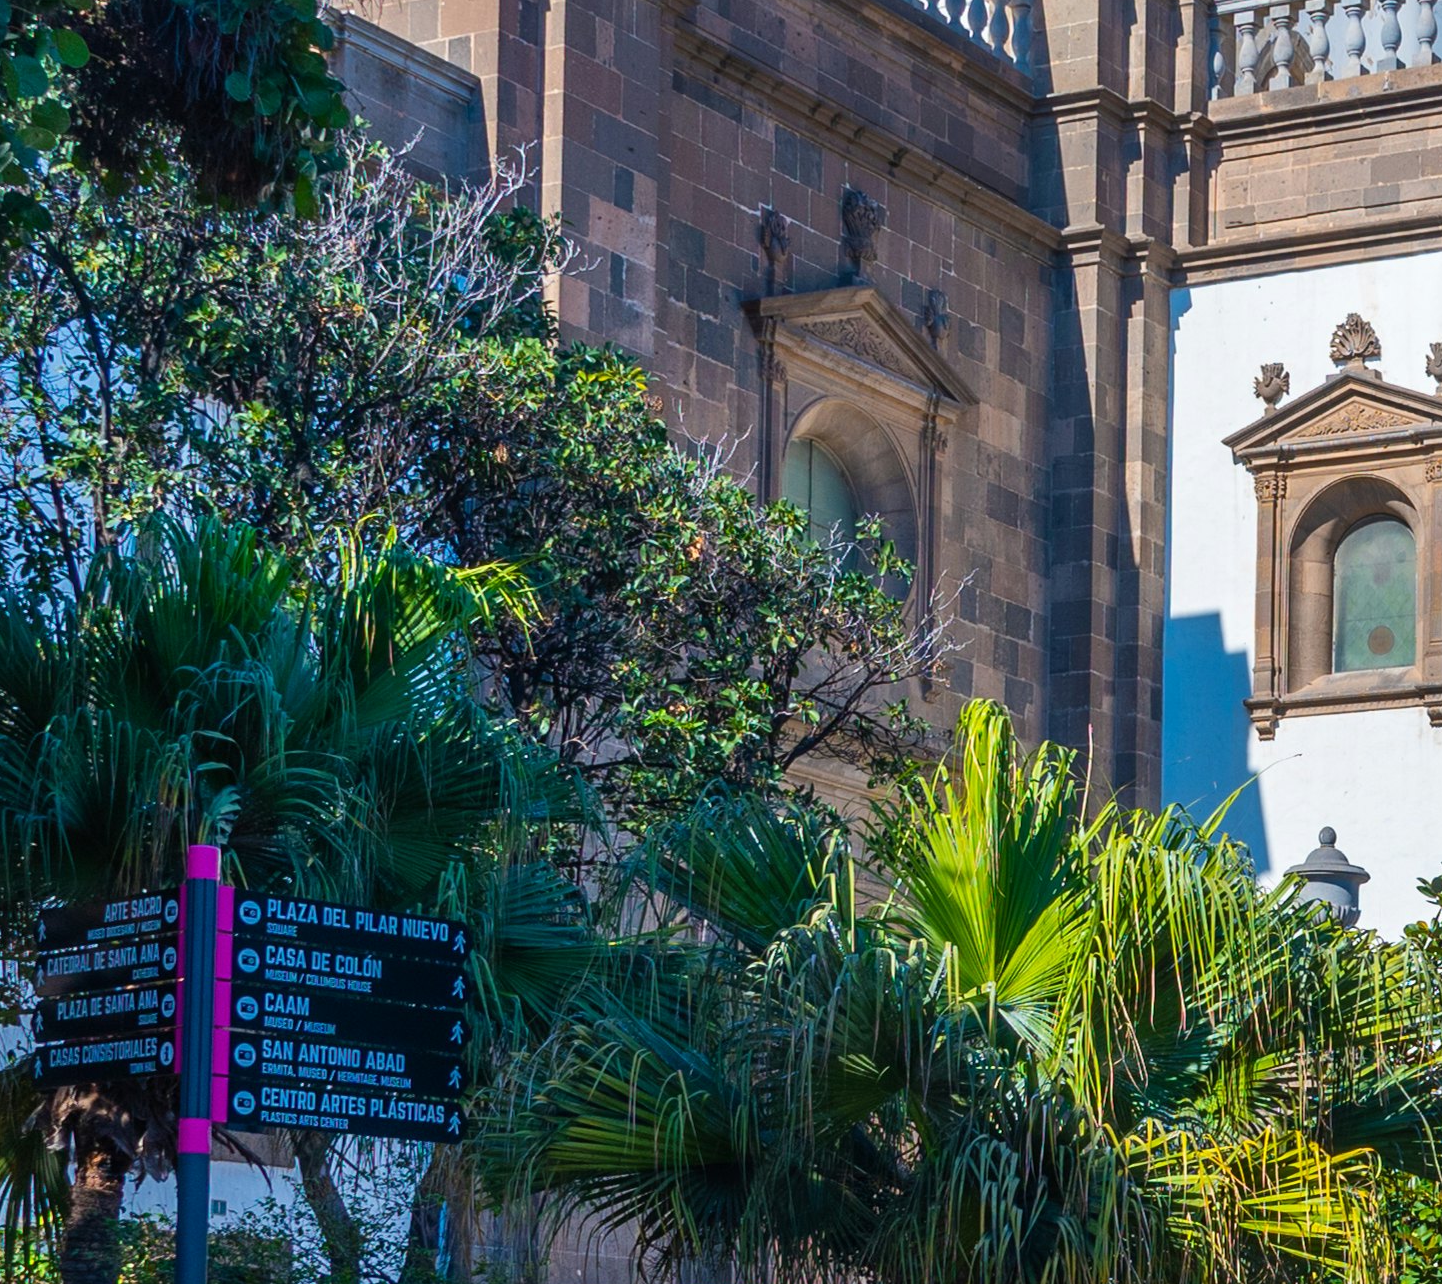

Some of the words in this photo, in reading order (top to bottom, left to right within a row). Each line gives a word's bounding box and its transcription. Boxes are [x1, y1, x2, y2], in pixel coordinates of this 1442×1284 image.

[104, 901, 129, 923] ARTE
[131, 895, 162, 918] SACRO
[267, 898, 318, 925] PLAZA
[323, 907, 350, 929] DEL
[355, 911, 398, 936] PILAR
[402, 918, 449, 942] NUEVO
[266, 922, 298, 937] SQUARE
[47, 953, 91, 977] CATEDRAL
[94, 951, 106, 971] DE
[108, 946, 137, 968] SANTA
[140, 943, 160, 964] ANA
[265, 945, 307, 969] CASA
[311, 950, 331, 972] DE
[335, 954, 382, 978] COLÓN
[265, 968, 297, 983] MUSEUM
[299, 973, 305, 984] /
[306, 974, 346, 990] COLUMBUS
[347, 979, 372, 993] HOUSE
[58, 1000, 88, 1021] PLAZA
[90, 997, 103, 1016] DE
[105, 993, 135, 1014] SANTA
[138, 989, 158, 1010] ANA
[264, 992, 310, 1016] CAAM
[264, 1016, 294, 1031] MUSEO
[295, 1020, 303, 1032] /
[304, 1021, 336, 1035] MUSEUM
[50, 1047, 80, 1067] CASAS
[82, 1037, 158, 1064] CONSISTORIALES
[262, 1039, 294, 1061] SAN
[298, 1043, 361, 1068] ANTONIO
[365, 1051, 406, 1073] ABAD
[298, 1066, 327, 1080] MUSEO
[329, 1070, 336, 1081] /
[380, 1075, 412, 1089] MUSEUM
[261, 1087, 316, 1111] CENTRO
[320, 1093, 366, 1116] ARTES
[370, 1096, 445, 1124] PLÁSTICAS
[261, 1110, 297, 1124] PLASTICS
[299, 1115, 319, 1127] ARTS
[320, 1117, 349, 1130] CENTER
